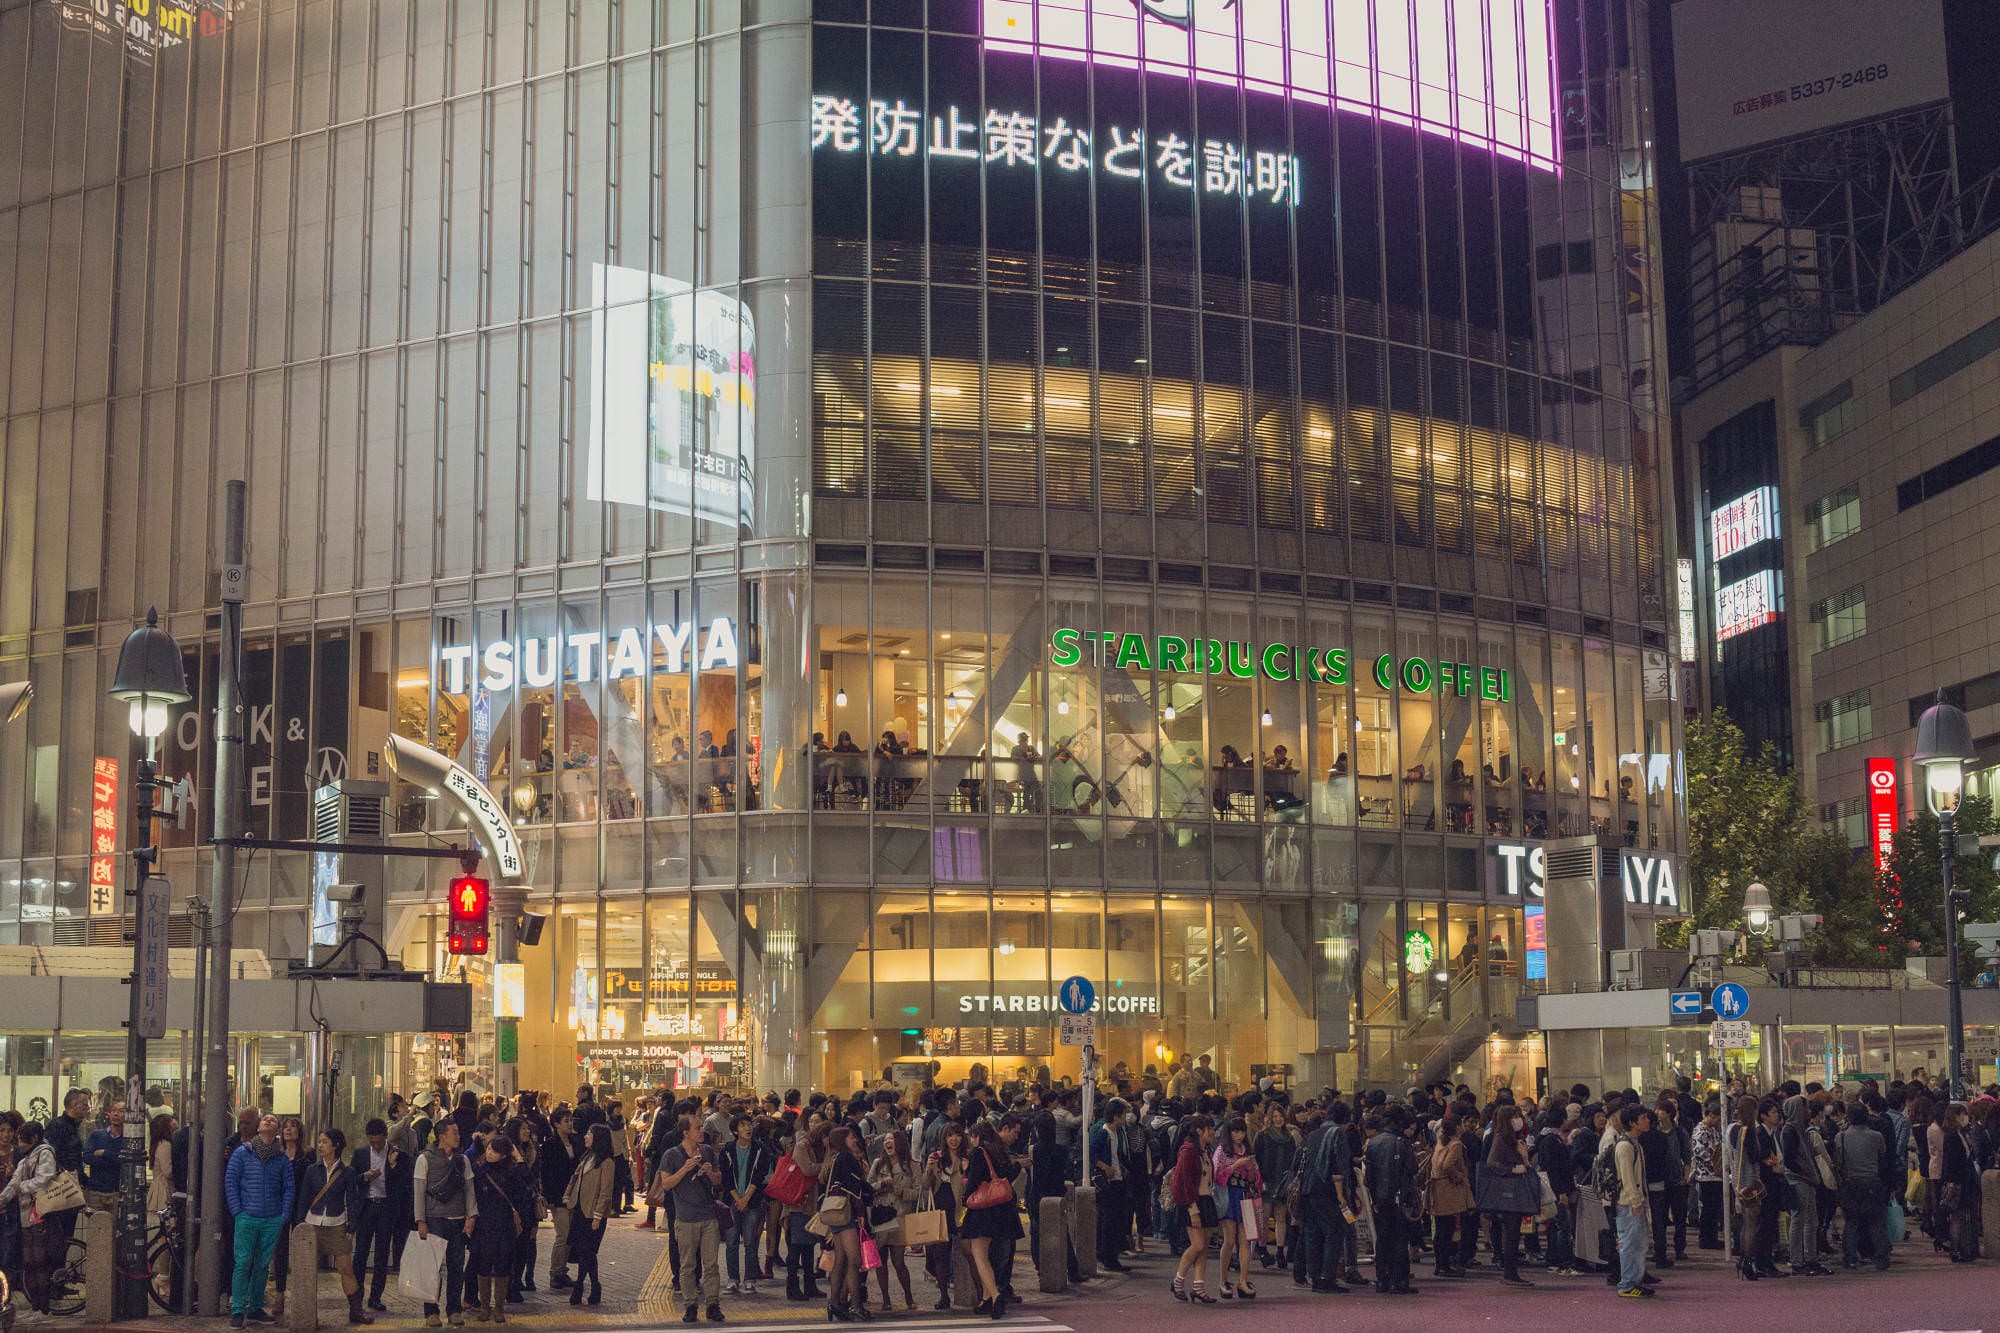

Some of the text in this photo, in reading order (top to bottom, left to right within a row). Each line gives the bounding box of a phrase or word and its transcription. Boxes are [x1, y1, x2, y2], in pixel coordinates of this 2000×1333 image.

[1790, 64, 1888, 101] 5337-2468
[811, 95, 1300, 206] 発防止策などを説明
[441, 617, 737, 694] TSUTAYA
[1051, 627, 1348, 685] STARBUCKS
[287, 717, 305, 741] &
[452, 773, 517, 871] 渋谷センター街
[1499, 845, 1677, 906] TSYA
[145, 893, 159, 1012] 文化村通り
[959, 995, 1101, 1012] STARBUS
[1064, 1017, 1071, 1025] 15
[1064, 1035, 1071, 1043] 12
[1716, 1022, 1724, 1030] 15
[1717, 1039, 1725, 1047] 12
